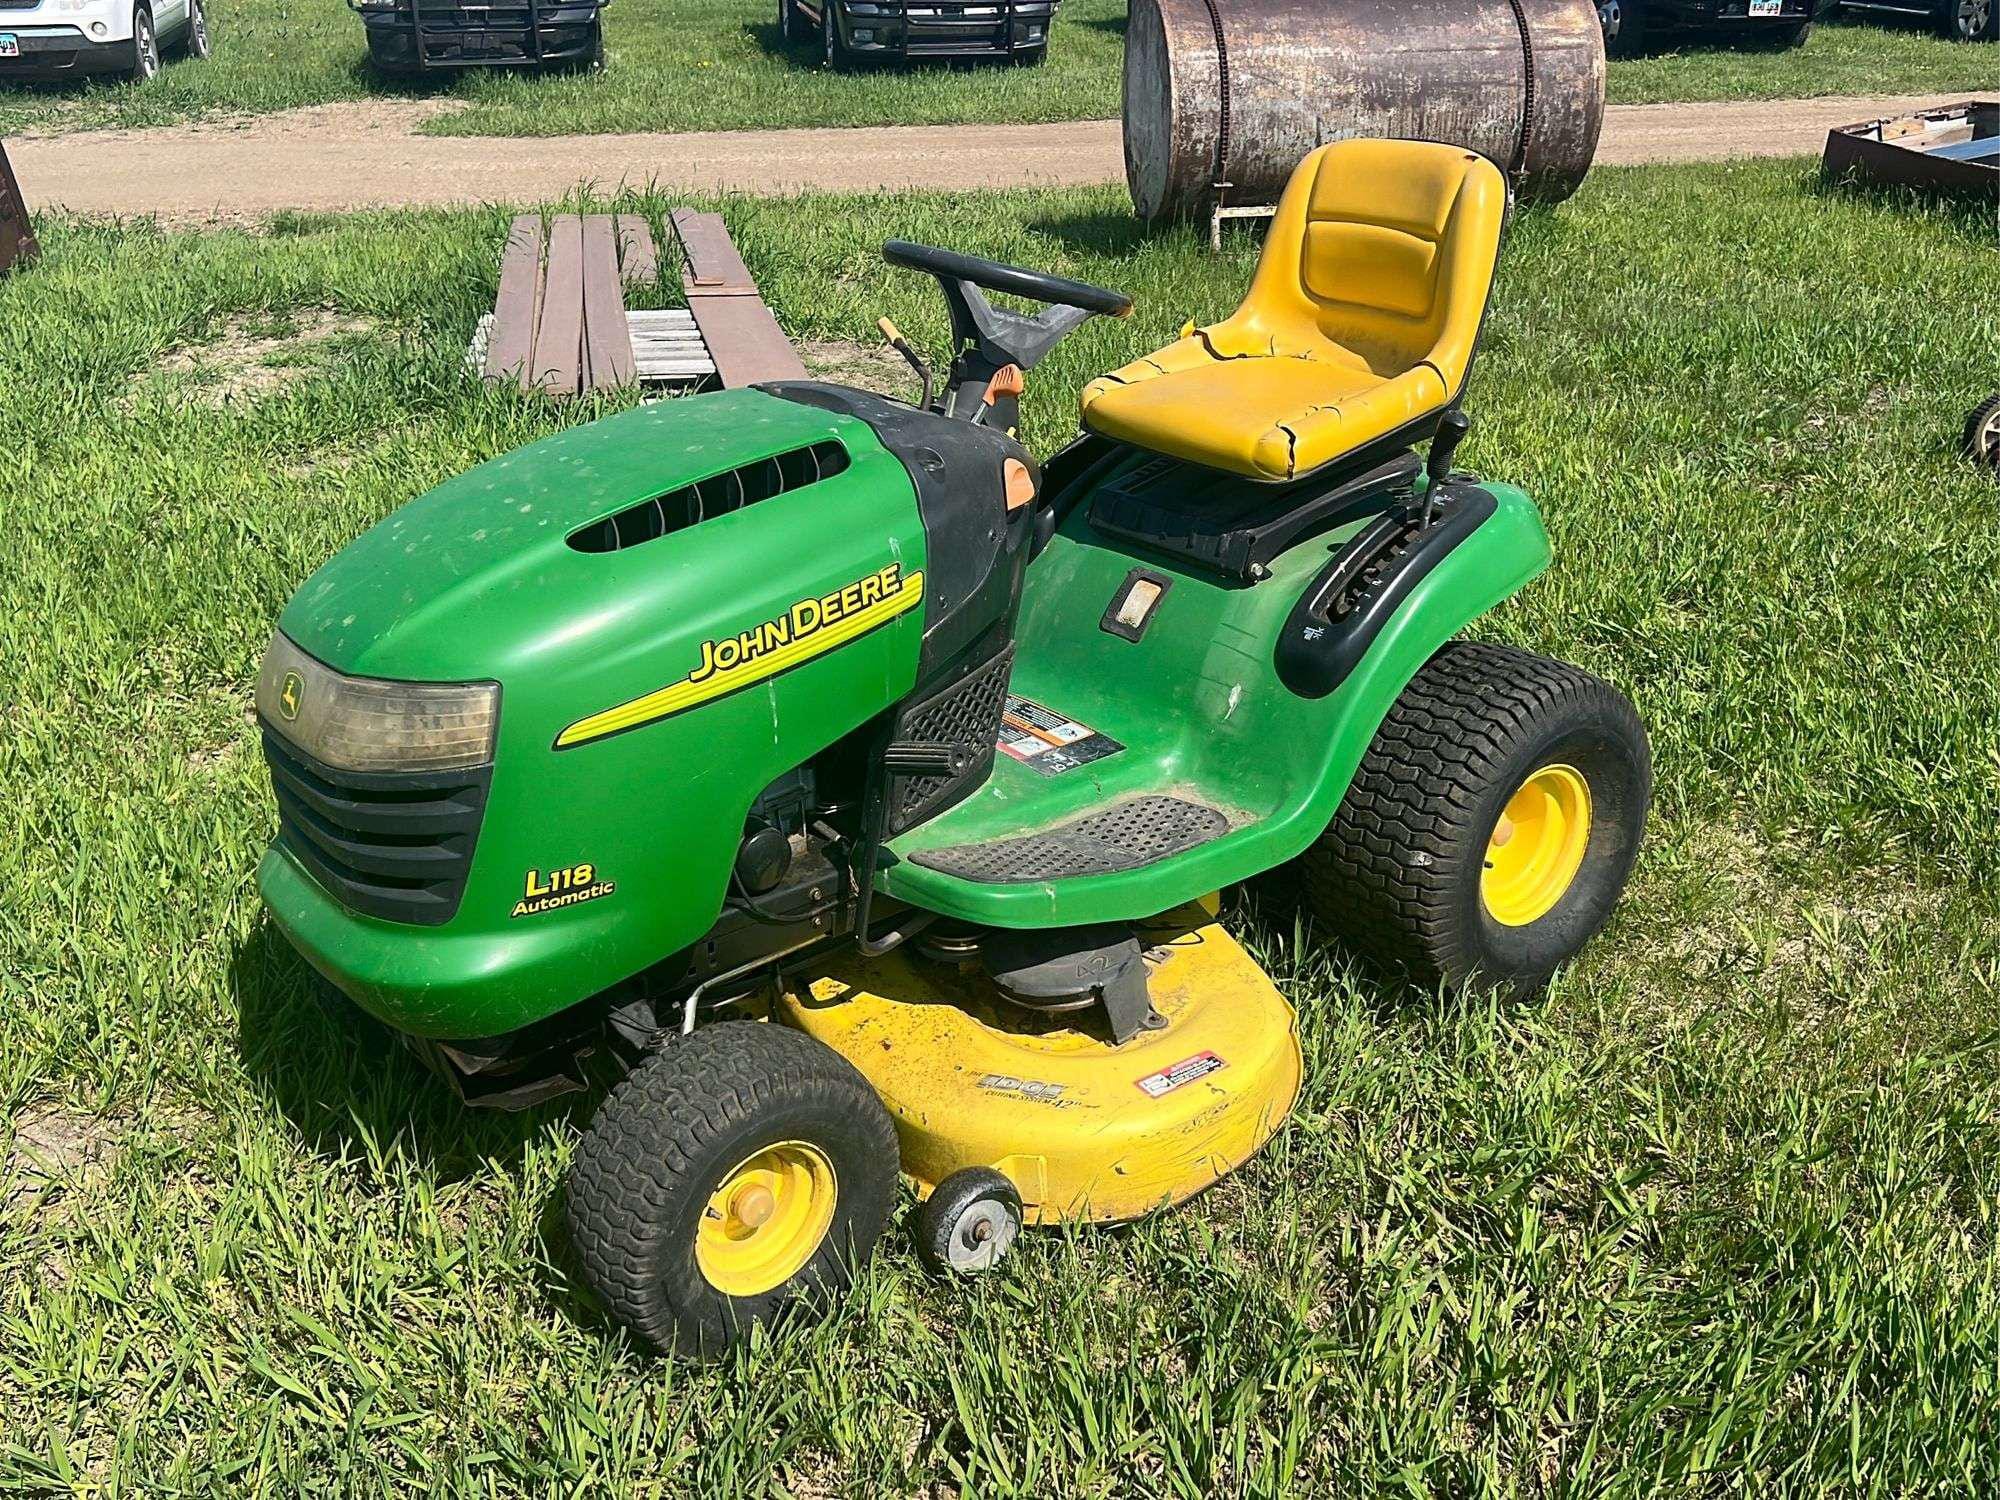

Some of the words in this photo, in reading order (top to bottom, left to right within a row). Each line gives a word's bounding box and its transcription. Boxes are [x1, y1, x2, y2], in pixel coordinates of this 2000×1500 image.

[689, 614, 790, 682] JOHN
[789, 562, 903, 640] DEERE
[525, 863, 594, 898] L118
[511, 881, 615, 917] Automatic
[976, 1073, 1065, 1099] EDGE
